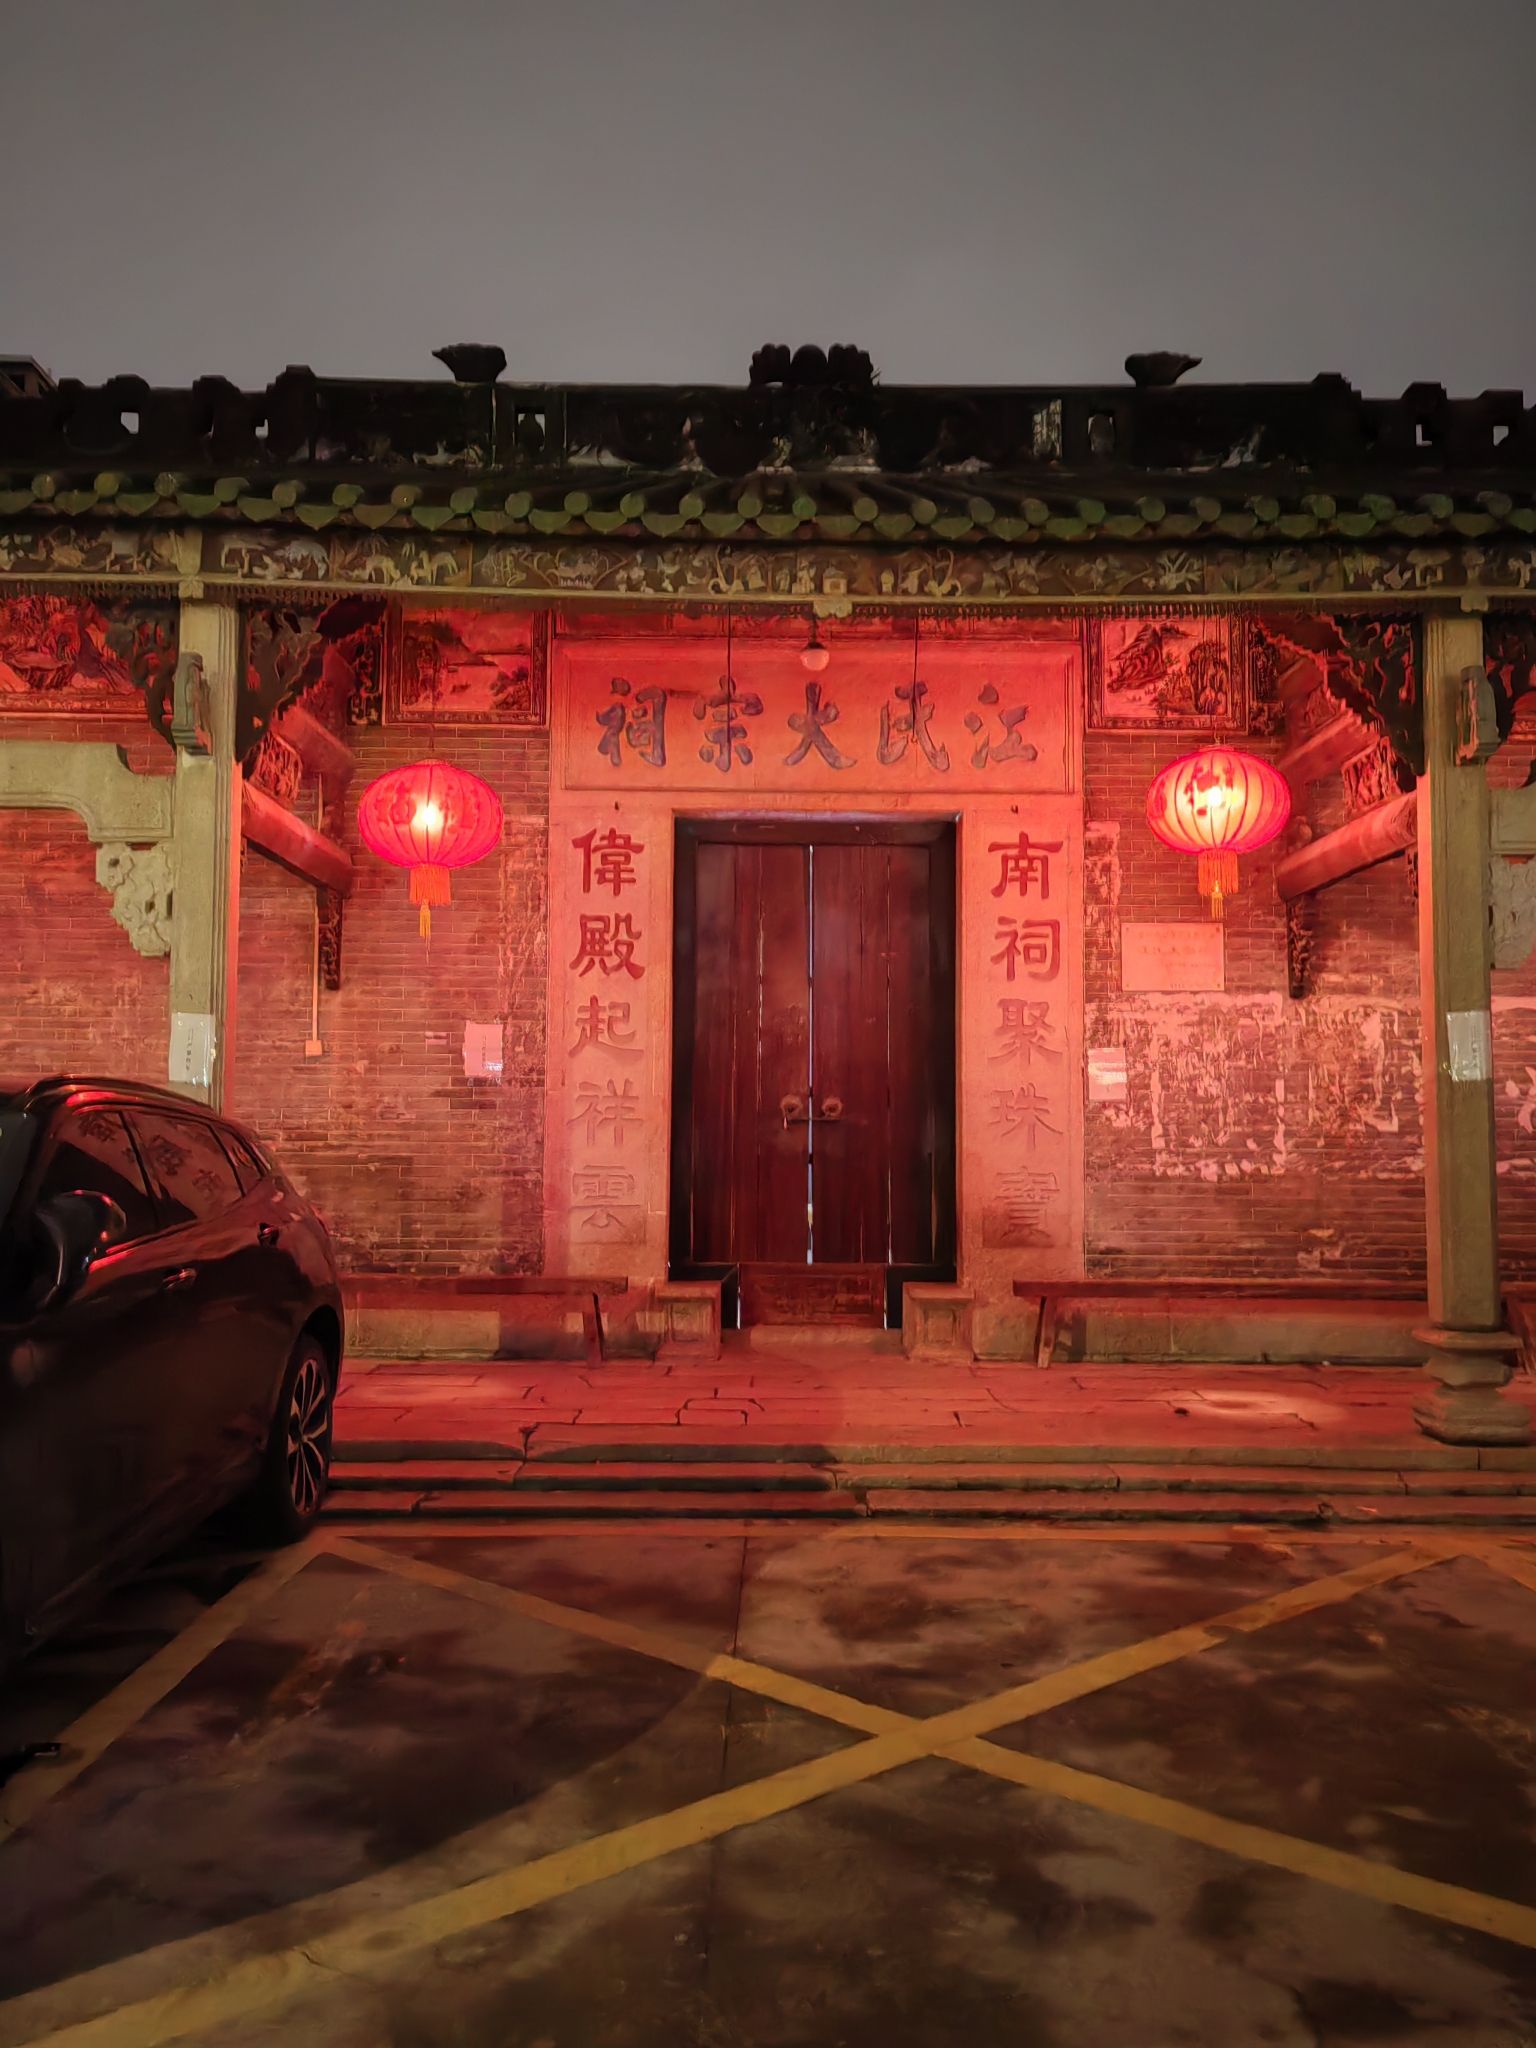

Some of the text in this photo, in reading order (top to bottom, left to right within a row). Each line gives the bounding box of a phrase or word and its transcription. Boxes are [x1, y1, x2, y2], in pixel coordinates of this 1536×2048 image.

[596, 676, 1038, 772] 江氏大宗祠
[568, 827, 646, 1228] 偉殿起祥雲
